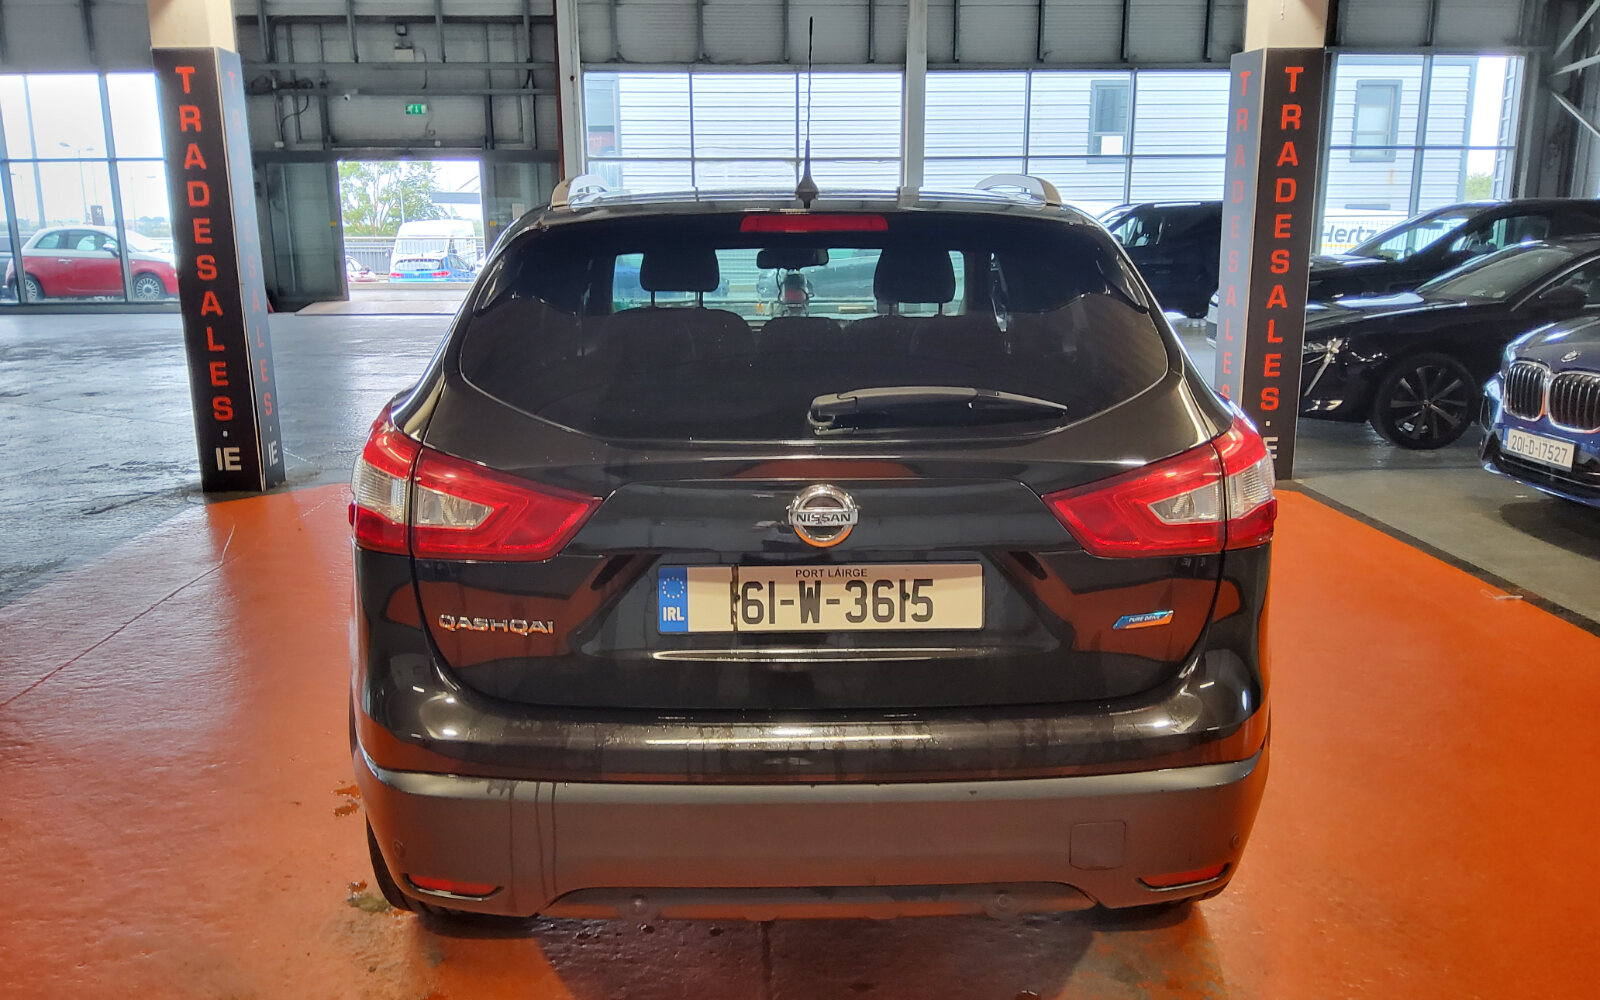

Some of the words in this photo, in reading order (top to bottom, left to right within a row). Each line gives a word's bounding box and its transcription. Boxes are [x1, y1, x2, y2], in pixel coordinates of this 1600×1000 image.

[1322, 225, 1377, 243] Hertz
[796, 513, 851, 523] NISSAN
[795, 568, 825, 578] PORT
[827, 567, 868, 578] LÁIRGE
[663, 606, 685, 621] IRL
[438, 613, 554, 636] QASHQAI
